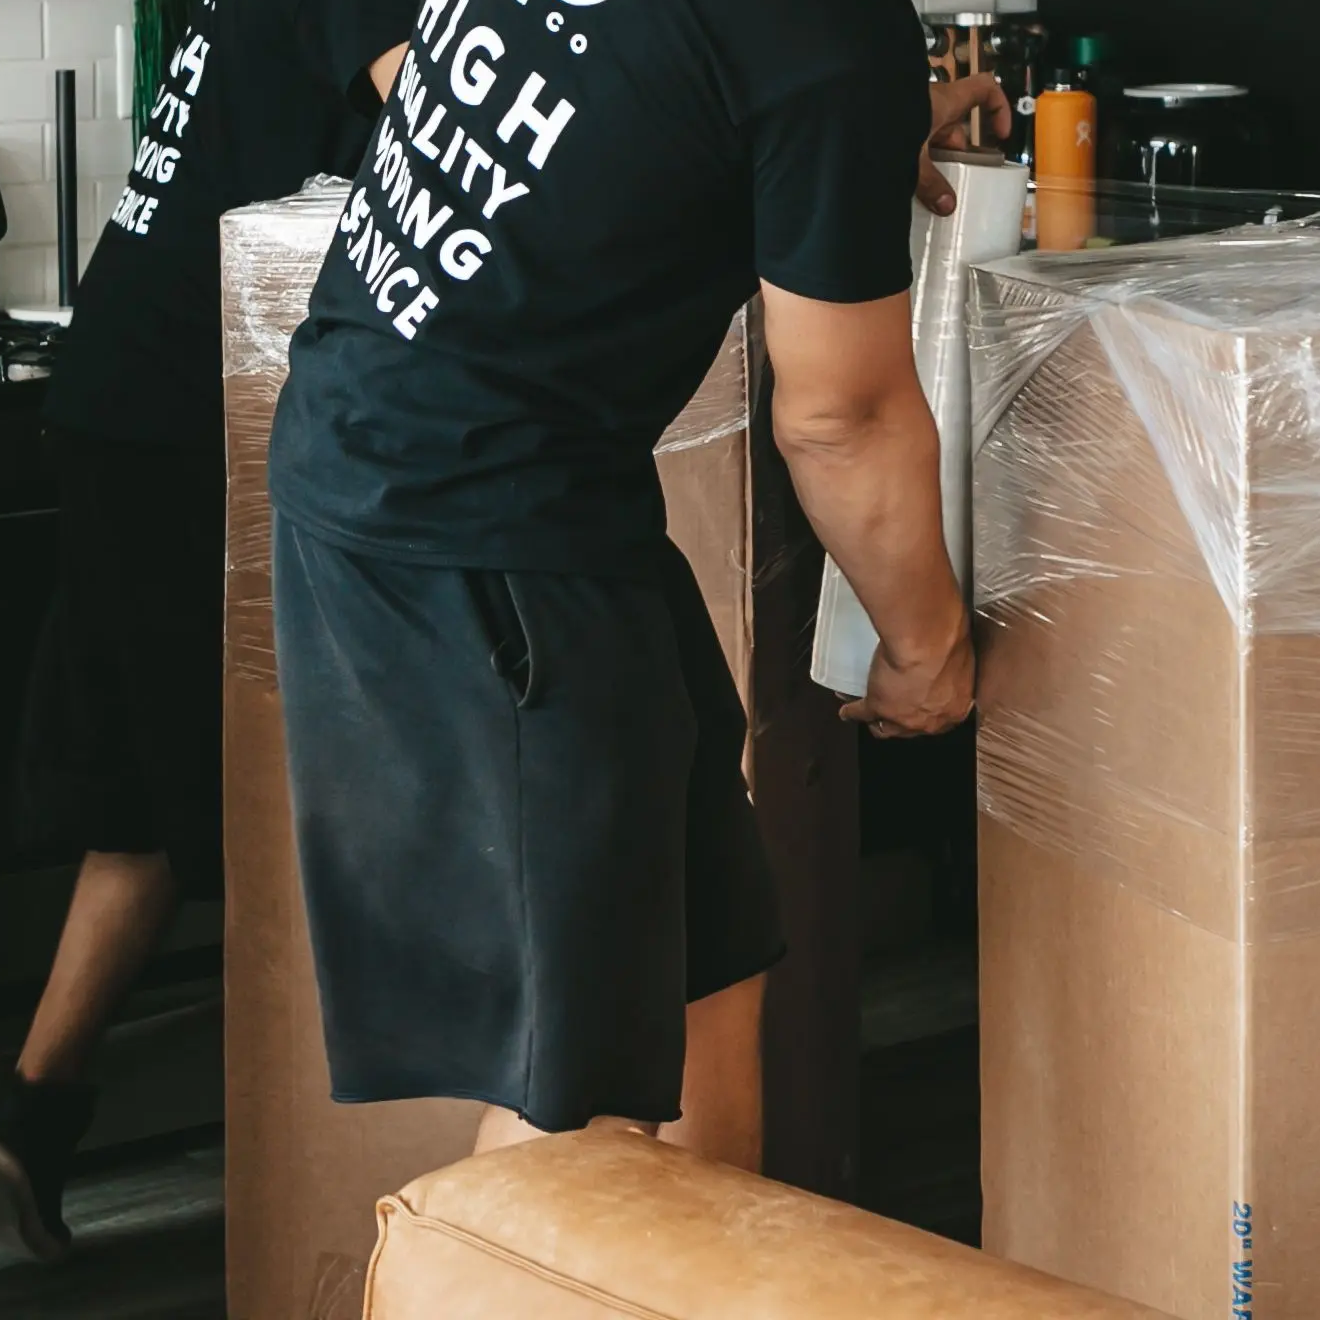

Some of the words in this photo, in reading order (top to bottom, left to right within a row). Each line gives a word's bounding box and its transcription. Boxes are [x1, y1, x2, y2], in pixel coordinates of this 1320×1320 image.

[546, 11, 588, 54] CO
[397, 49, 530, 220] QUALITY
[373, 115, 492, 280] MOVING
[1232, 1200, 1253, 1249] 20"
